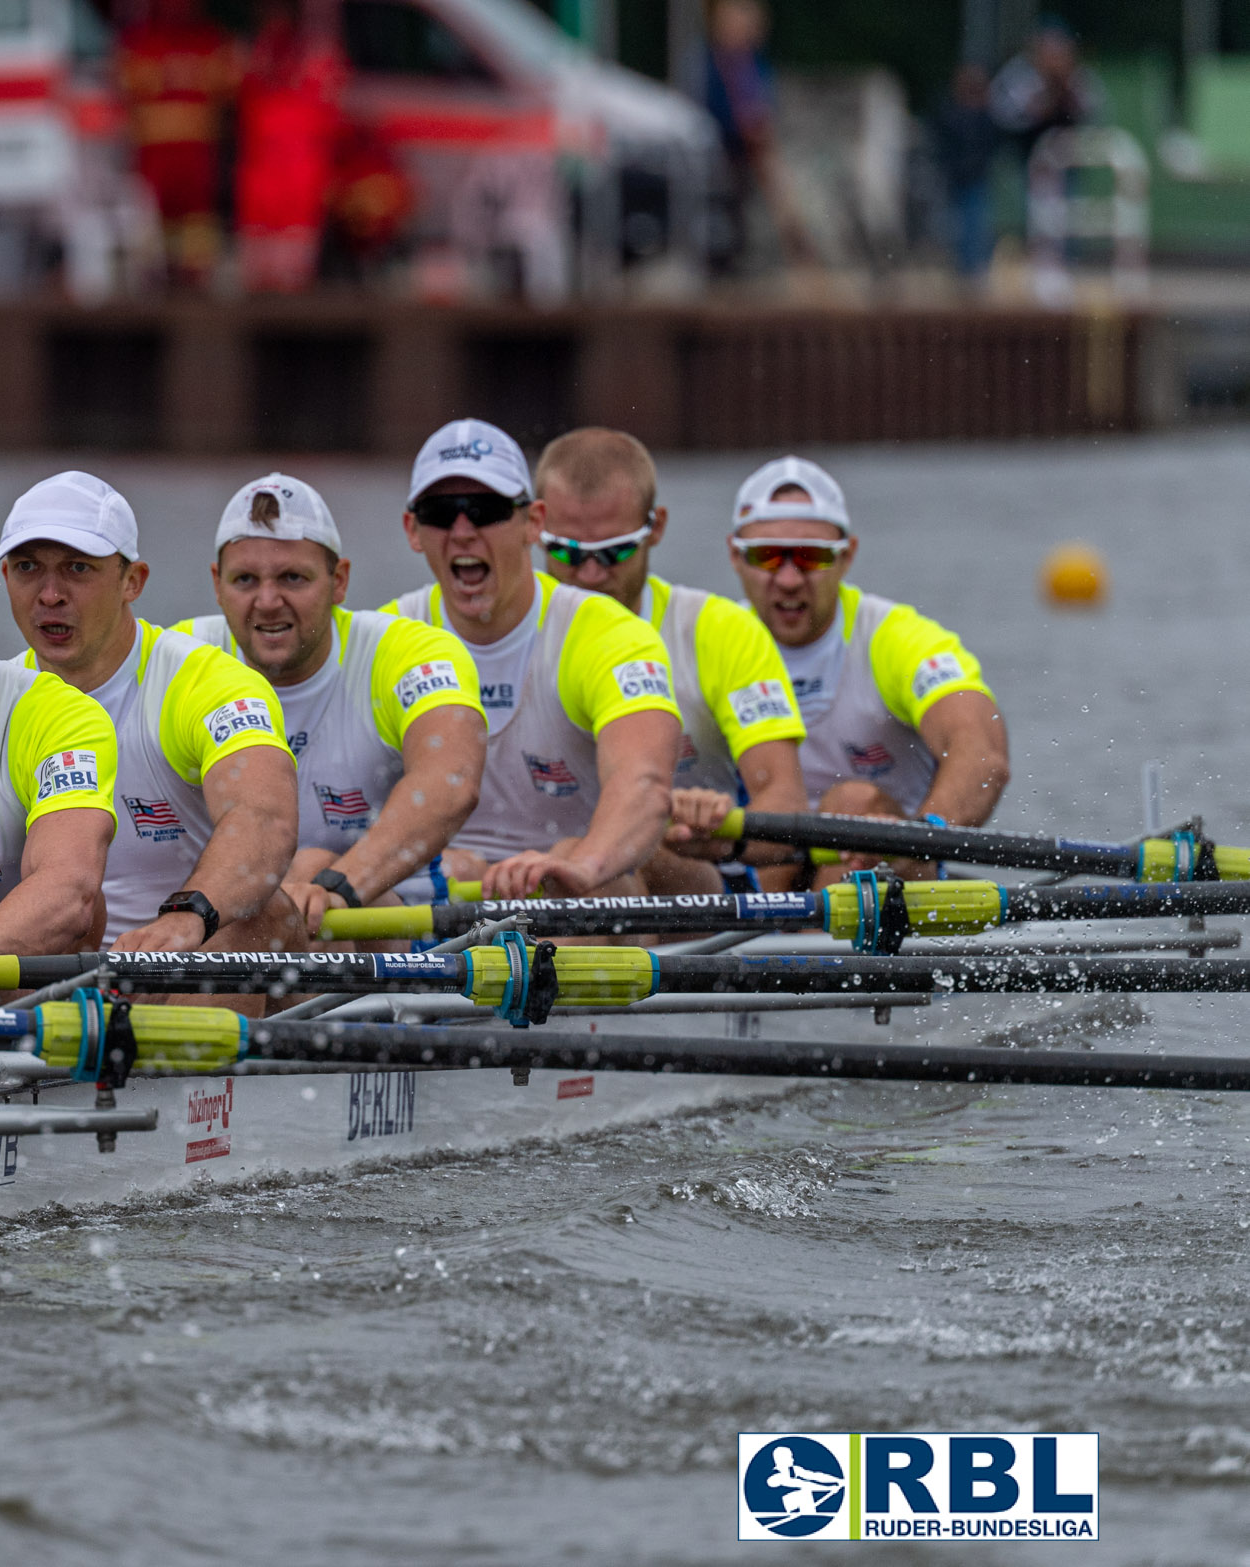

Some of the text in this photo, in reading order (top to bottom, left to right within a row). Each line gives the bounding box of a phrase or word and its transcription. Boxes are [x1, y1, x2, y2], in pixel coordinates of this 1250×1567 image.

[416, 675, 458, 695] RBL
[481, 683, 513, 697] WB
[230, 714, 272, 730] RBL
[54, 771, 98, 789] RBL
[565, 896, 672, 910] SCHNELL.
[675, 894, 729, 907] GUT.
[106, 950, 365, 964] STARK. SCHNELL. GUT.
[347, 1072, 415, 1141] BERLIN
